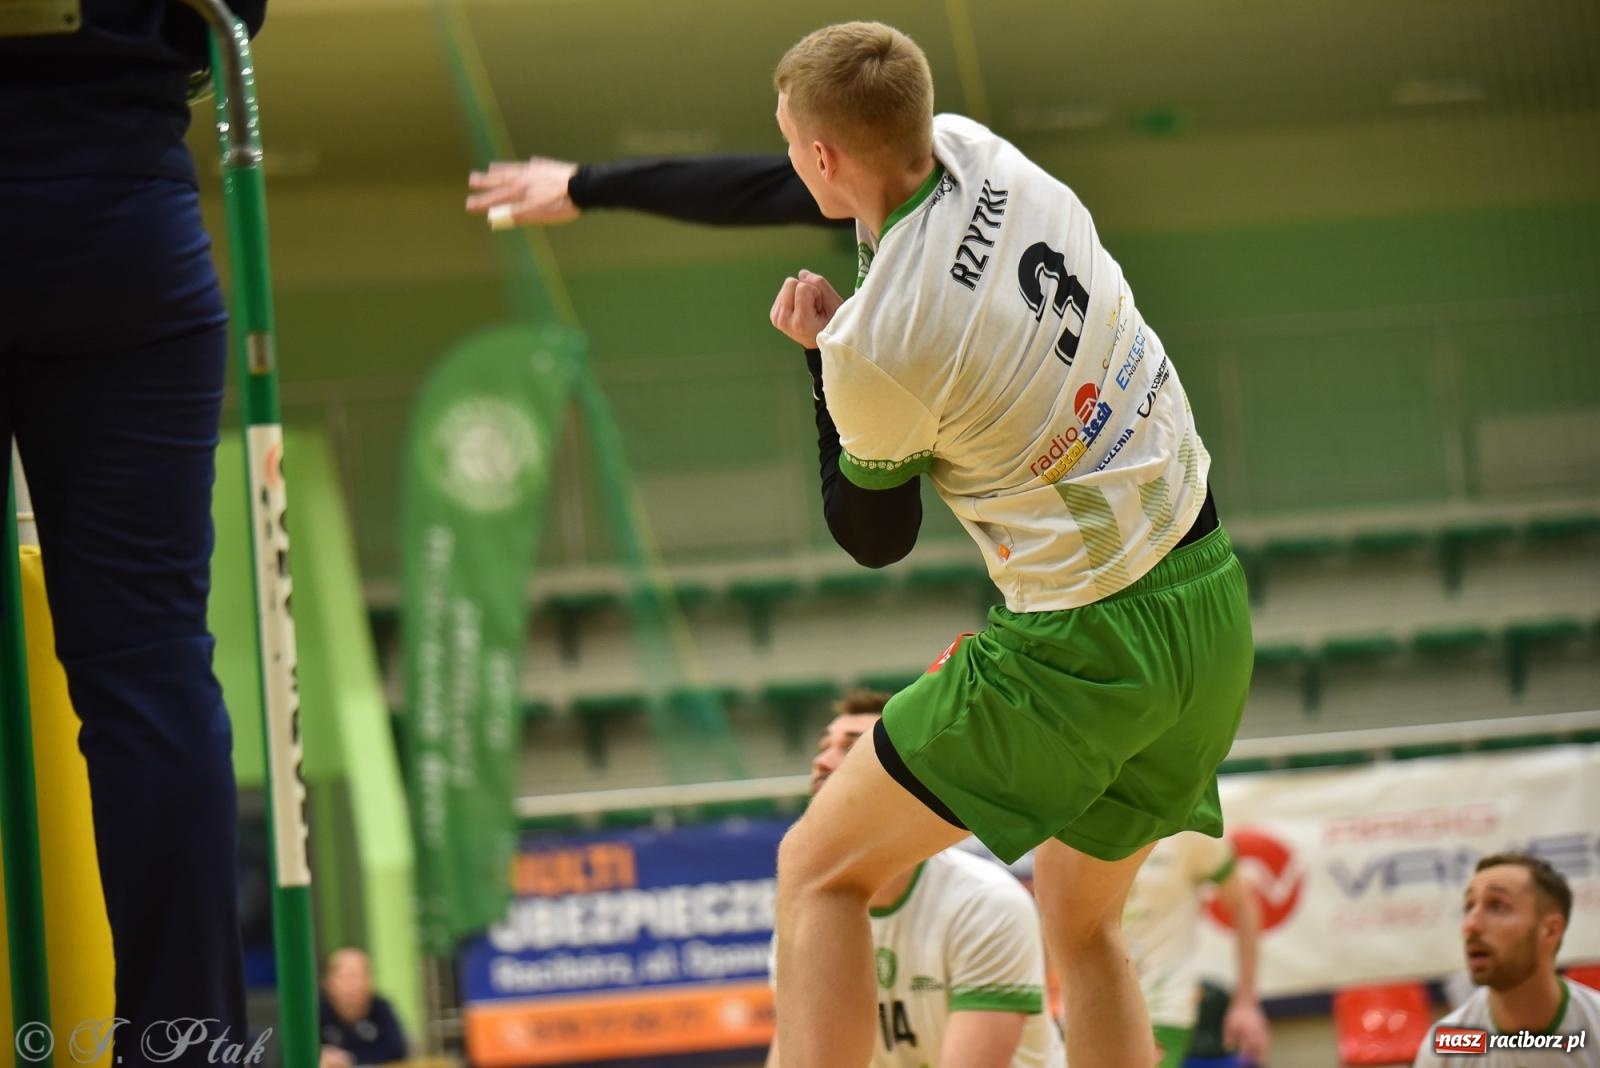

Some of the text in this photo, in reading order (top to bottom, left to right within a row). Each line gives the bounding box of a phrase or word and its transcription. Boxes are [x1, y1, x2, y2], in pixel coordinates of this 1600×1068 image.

[950, 178, 1009, 291] RZYTKI
[1017, 241, 1090, 367] 3
[1030, 426, 1078, 477] radio
[1095, 428, 1135, 472] ECZENIA
[878, 1000, 918, 1052] 14
